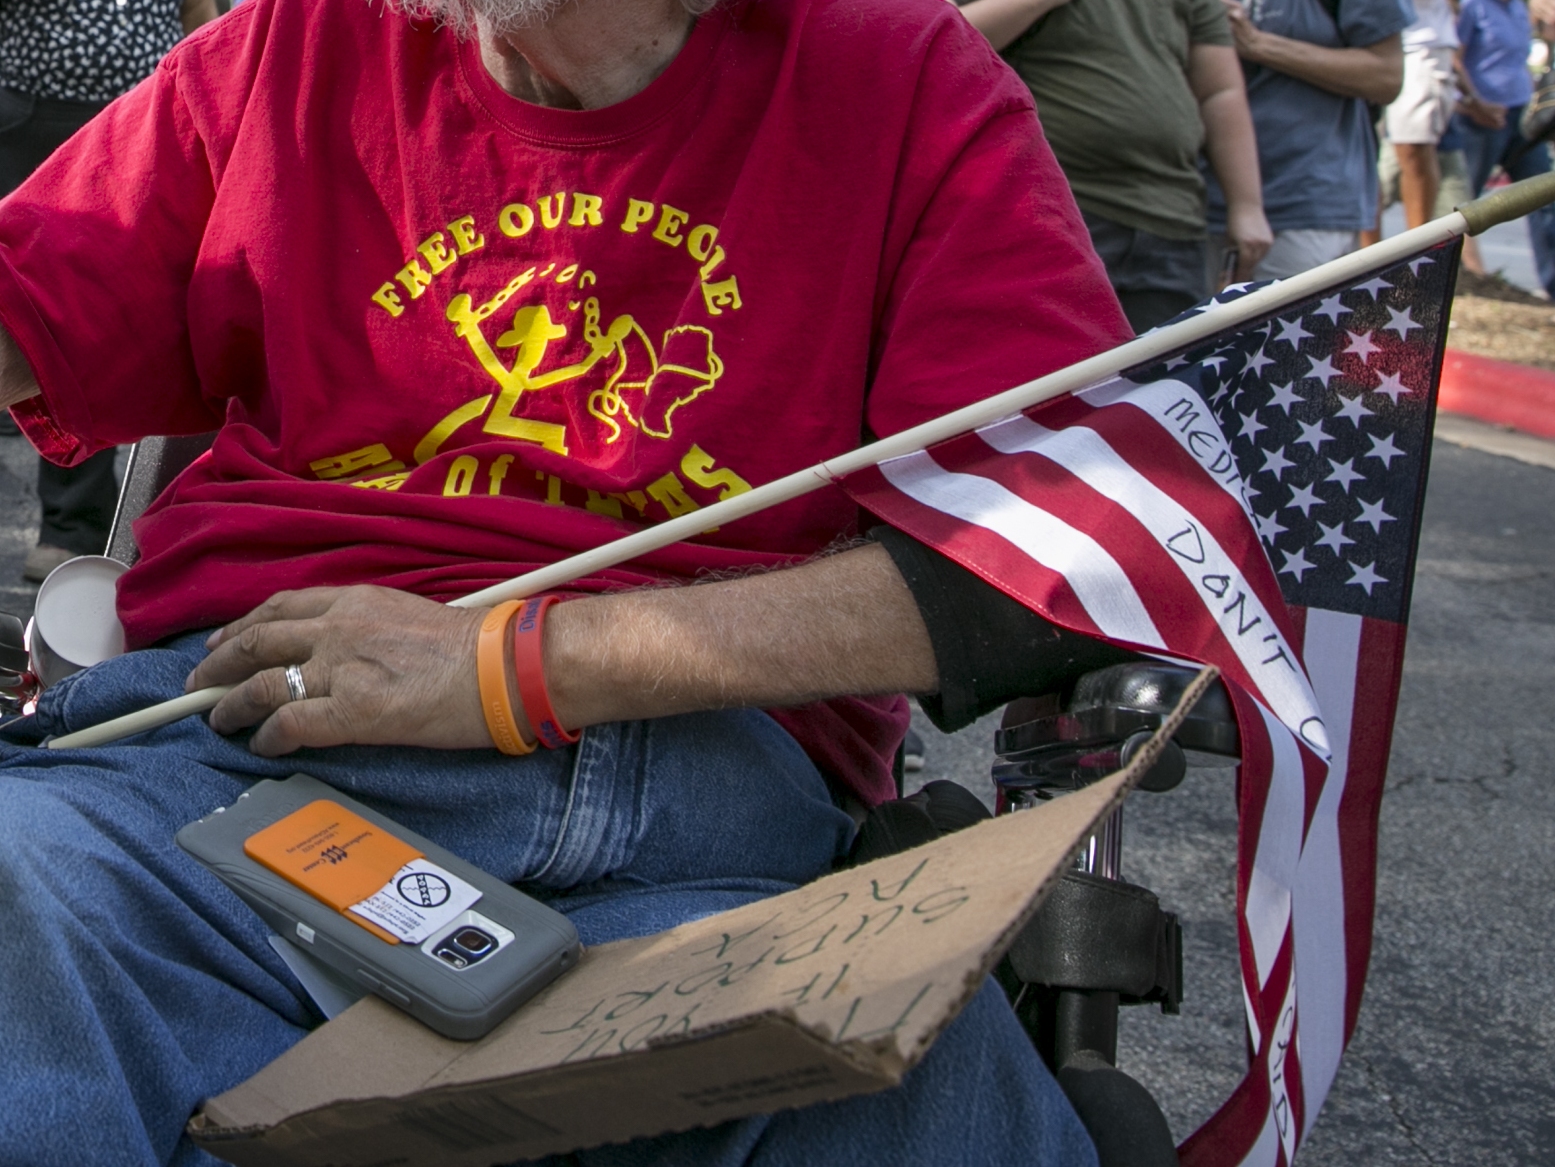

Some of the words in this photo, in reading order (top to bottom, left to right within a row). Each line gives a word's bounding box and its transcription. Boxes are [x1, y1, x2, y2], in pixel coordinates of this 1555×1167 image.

[371, 215, 486, 318] FREE
[498, 191, 604, 238] OUR
[1166, 519, 1297, 674] DON'T
